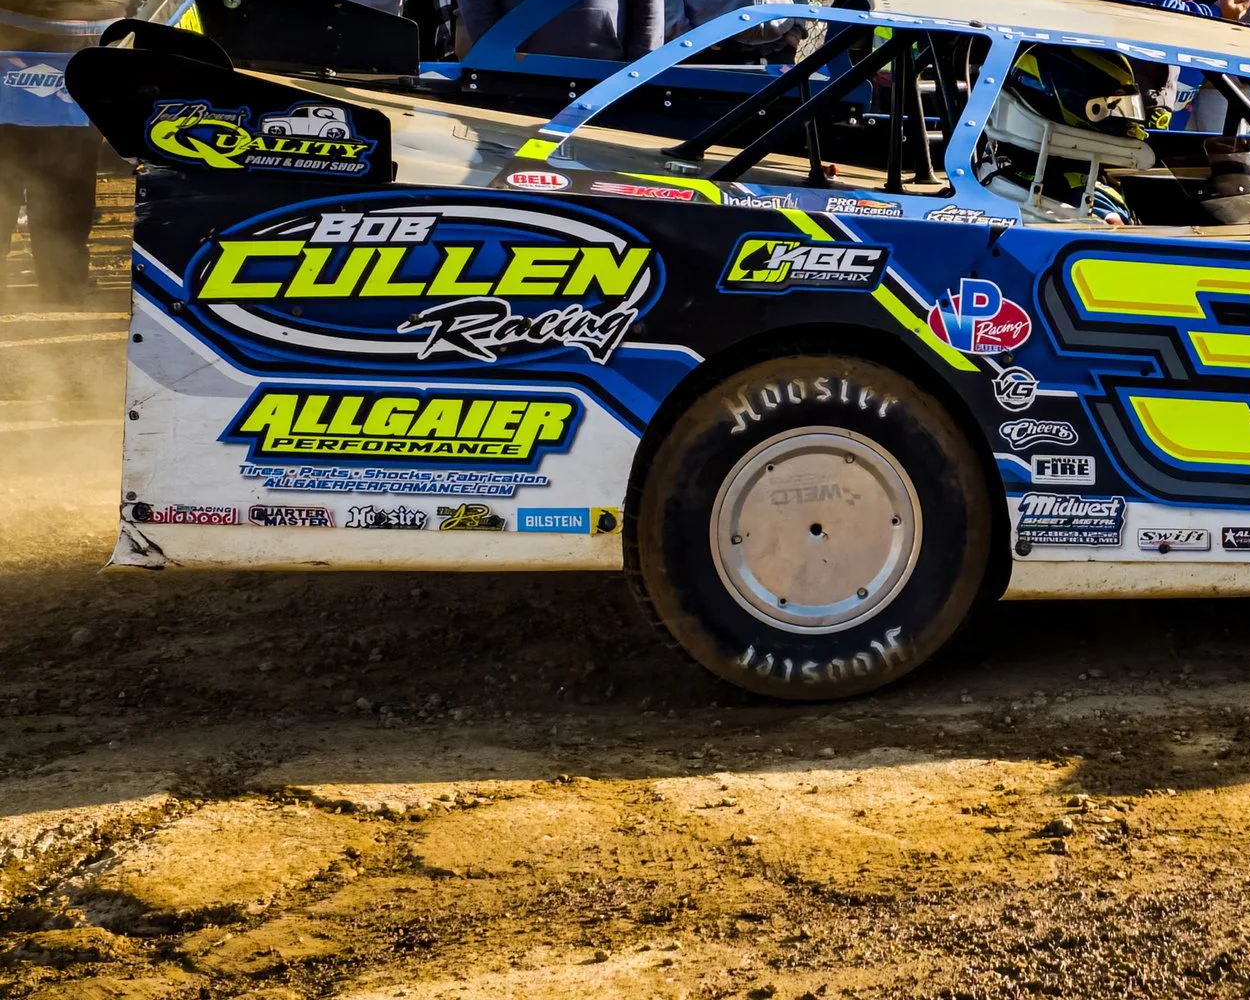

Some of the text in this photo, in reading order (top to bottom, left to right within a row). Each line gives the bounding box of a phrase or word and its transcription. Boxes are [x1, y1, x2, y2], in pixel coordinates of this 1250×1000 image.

[150, 116, 369, 169] QUALITY
[244, 154, 365, 172] PAINT & BODY SHOP
[513, 174, 562, 186] BELL
[828, 197, 857, 206] PRO
[309, 212, 437, 243] BOB
[764, 244, 882, 272] KBC
[197, 240, 652, 299] CULLEN
[789, 270, 871, 282] GRAPHIX
[935, 278, 1003, 352] VP
[398, 296, 637, 364] Racing
[976, 319, 1030, 343] Racing
[993, 380, 1036, 398] VG
[722, 371, 900, 434] Hoosier
[239, 393, 572, 442] ALLGAIER
[1003, 422, 1074, 441] Cheers
[271, 438, 522, 456] PERFORMANCE
[239, 465, 548, 485] Tires Parts Shocks Fabrication
[1036, 460, 1090, 476] FIRE
[263, 477, 515, 496] ALLGAIERPERFORMANCE.COM
[1022, 495, 1120, 517] Midwest
[264, 517, 329, 526] MASTER
[348, 505, 427, 528] Hosier
[525, 515, 583, 528] BILSTEIN
